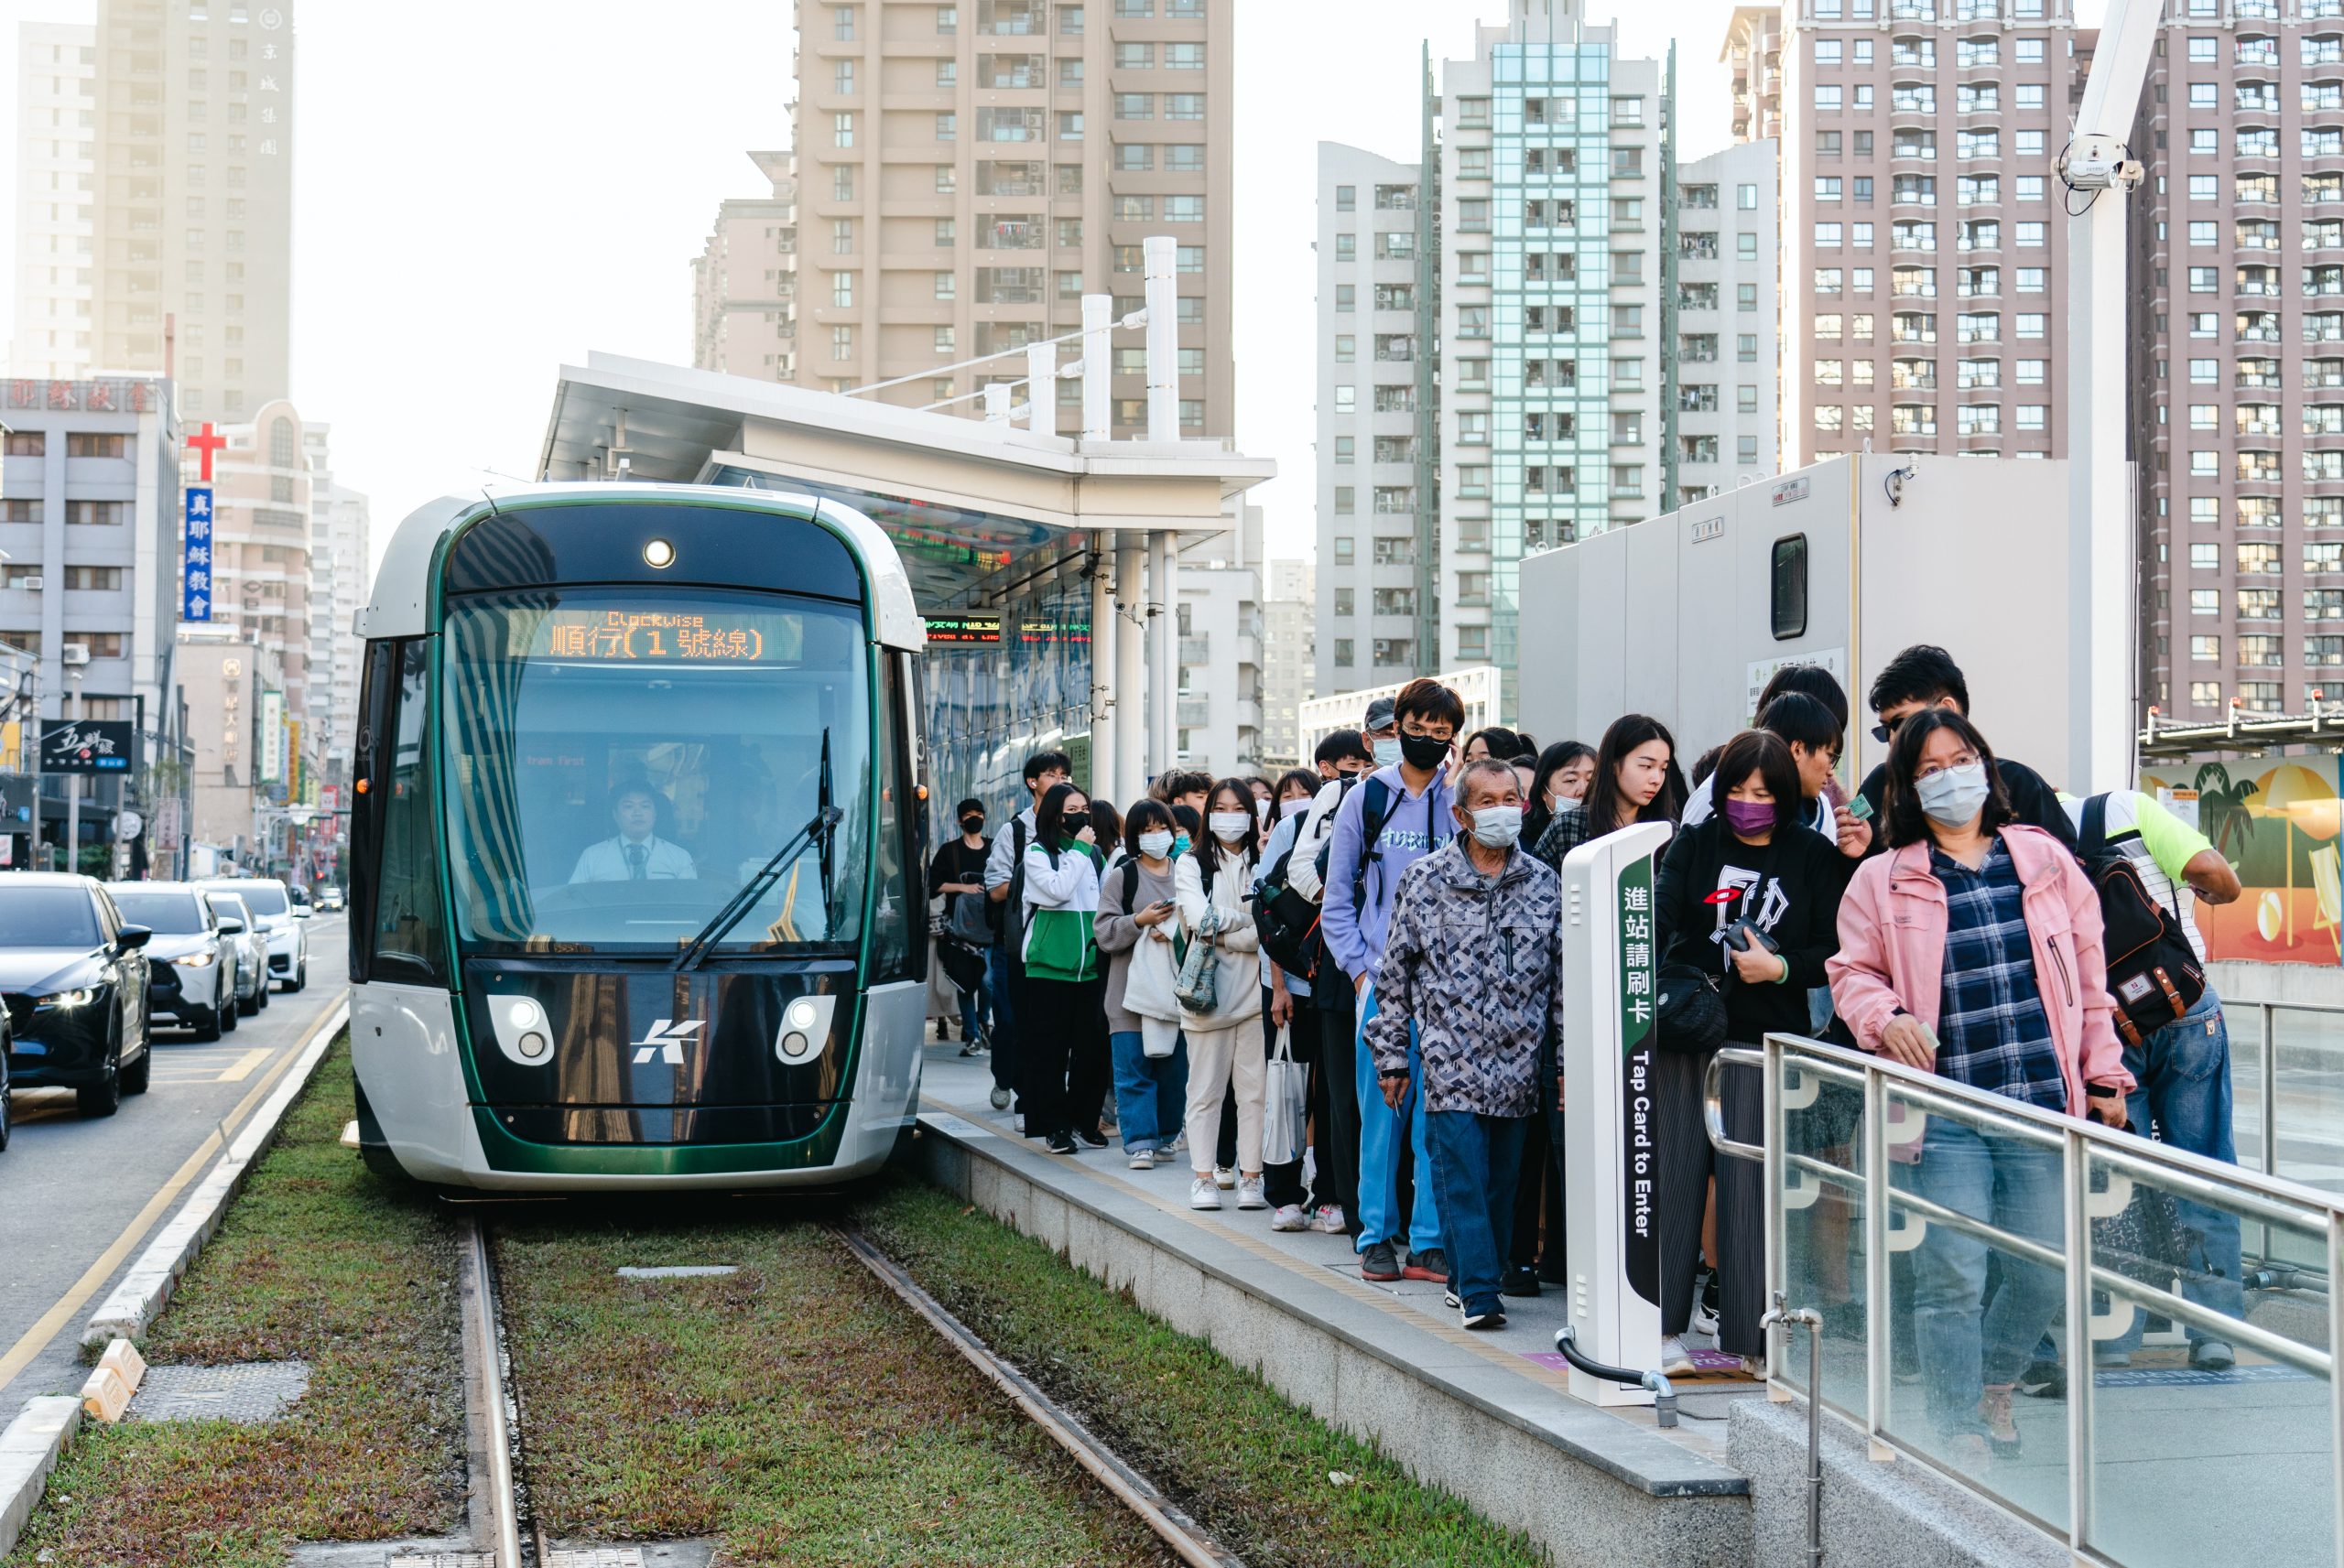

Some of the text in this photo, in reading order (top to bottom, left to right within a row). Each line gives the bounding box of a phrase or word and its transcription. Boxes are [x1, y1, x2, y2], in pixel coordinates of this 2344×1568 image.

[187, 493, 211, 618] 真耶穌教會
[608, 611, 704, 628] Clockwise
[1624, 886, 1652, 1024] 進站請刷卡
[1630, 1050, 1652, 1238] Tap Card to Enter
